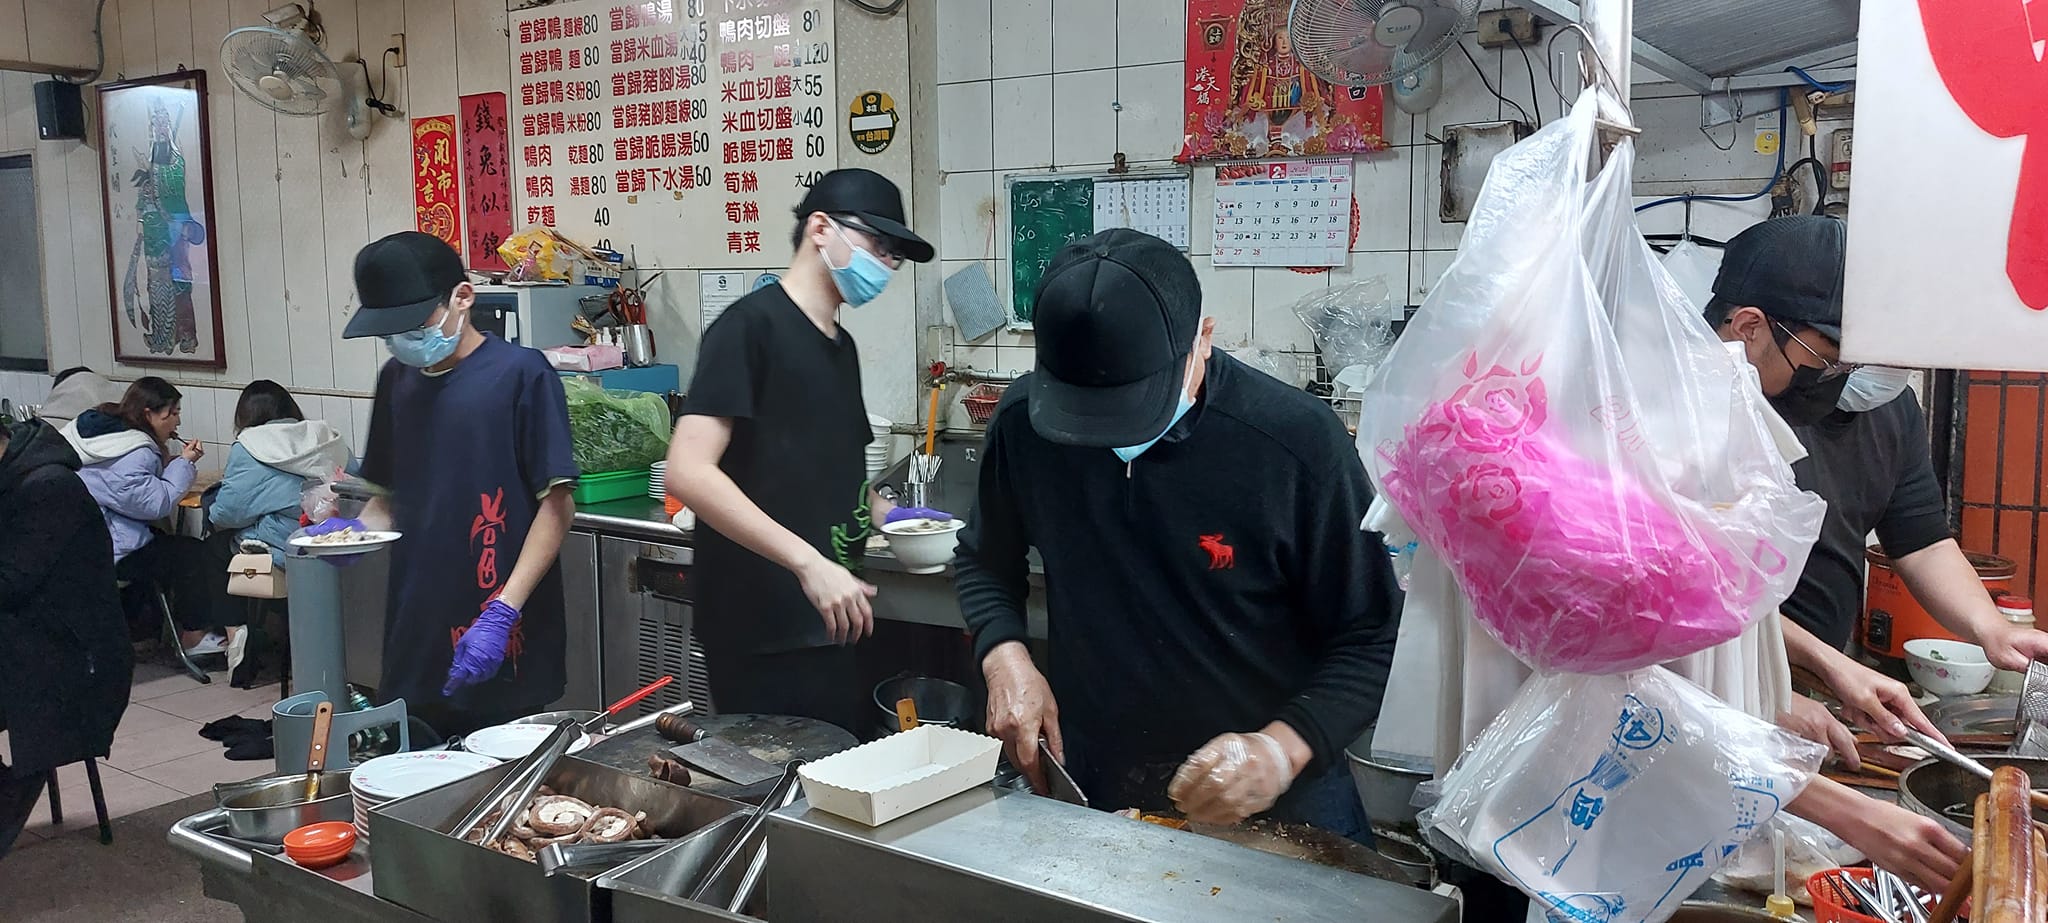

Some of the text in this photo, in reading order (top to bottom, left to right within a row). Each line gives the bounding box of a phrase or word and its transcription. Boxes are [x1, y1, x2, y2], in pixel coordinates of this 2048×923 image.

[609, 1, 673, 31] 當歸鴨湯
[719, 9, 821, 43] 鴨肉切盤 80
[519, 14, 598, 43] 當歸鴨 麵線 80
[610, 32, 678, 64] 當歸米血湯
[804, 42, 829, 65] 120
[520, 46, 599, 75] 當歸鴨 麵 80
[521, 79, 600, 106] 當歸鴨 冬粉 80
[611, 64, 707, 97] 當歸豬腳湯 80
[721, 75, 792, 103] 米血切盤
[804, 74, 823, 97] 55
[522, 111, 601, 137] 當歸鴨 米粉 80
[612, 98, 707, 129] 當歸豬腳麵線 80
[722, 106, 793, 133] 米血切盤
[803, 106, 823, 128] 40
[693, 130, 709, 153] 60
[806, 134, 824, 158] 60
[524, 144, 604, 167] 鴨肉 乾麵 80
[526, 174, 607, 198] 鴨肉 湯麵 80
[615, 164, 711, 193] 當歸下水湯 60
[724, 170, 758, 194] 筍絲
[527, 205, 610, 227] 乾麵 40
[725, 200, 759, 224] 筍絲
[1310, 200, 1319, 208] 10
[1253, 217, 1262, 225] 14
[1290, 216, 1299, 224] 16
[1309, 216, 1318, 224] 17
[1328, 216, 1338, 224] 18
[726, 230, 761, 254] 青菜
[1290, 232, 1299, 240] 23
[1308, 232, 1317, 240] 24
[1327, 232, 1336, 240] 25
[1233, 248, 1243, 256] 27
[1252, 248, 1261, 256] 28
